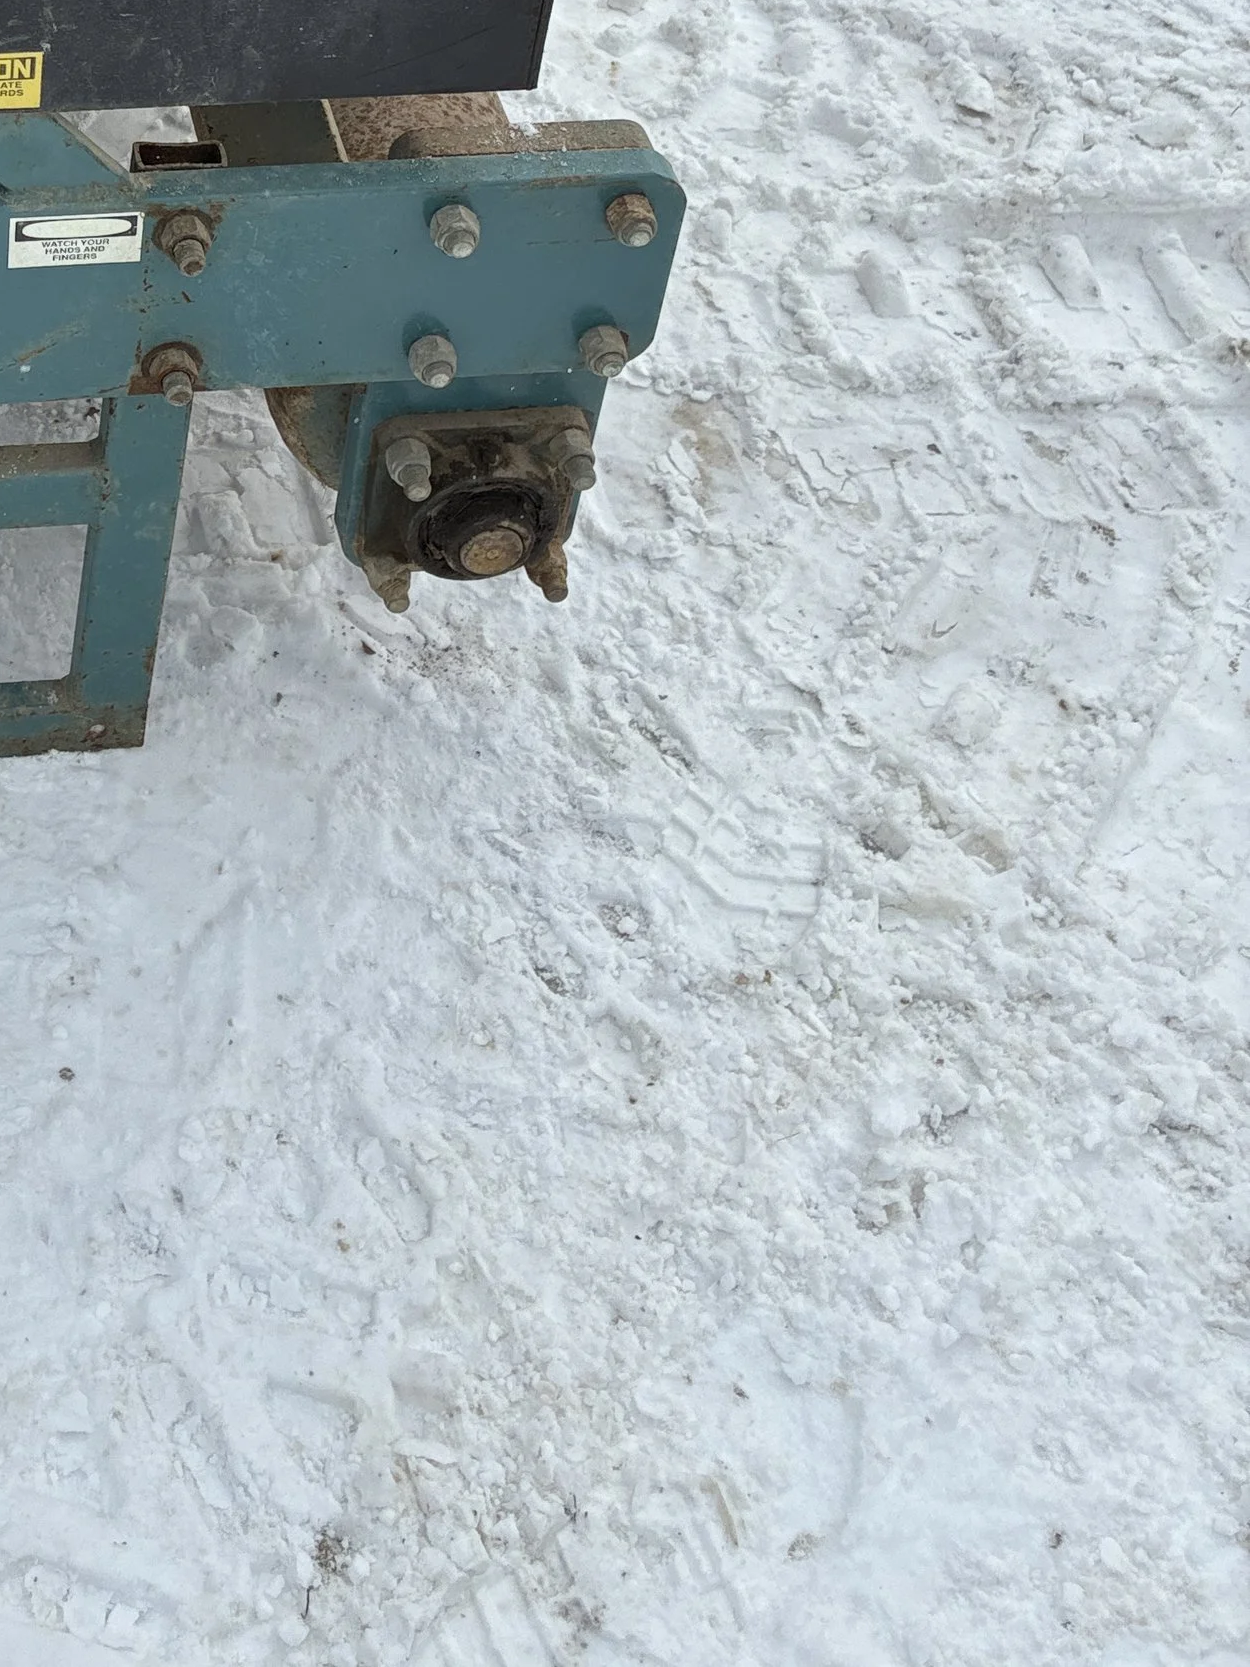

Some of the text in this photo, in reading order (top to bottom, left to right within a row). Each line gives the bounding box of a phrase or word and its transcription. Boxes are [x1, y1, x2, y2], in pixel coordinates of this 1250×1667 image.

[41, 238, 110, 248] WATCH YOUR
[44, 245, 105, 255] HANDS AND
[52, 253, 98, 261] FINGERS
